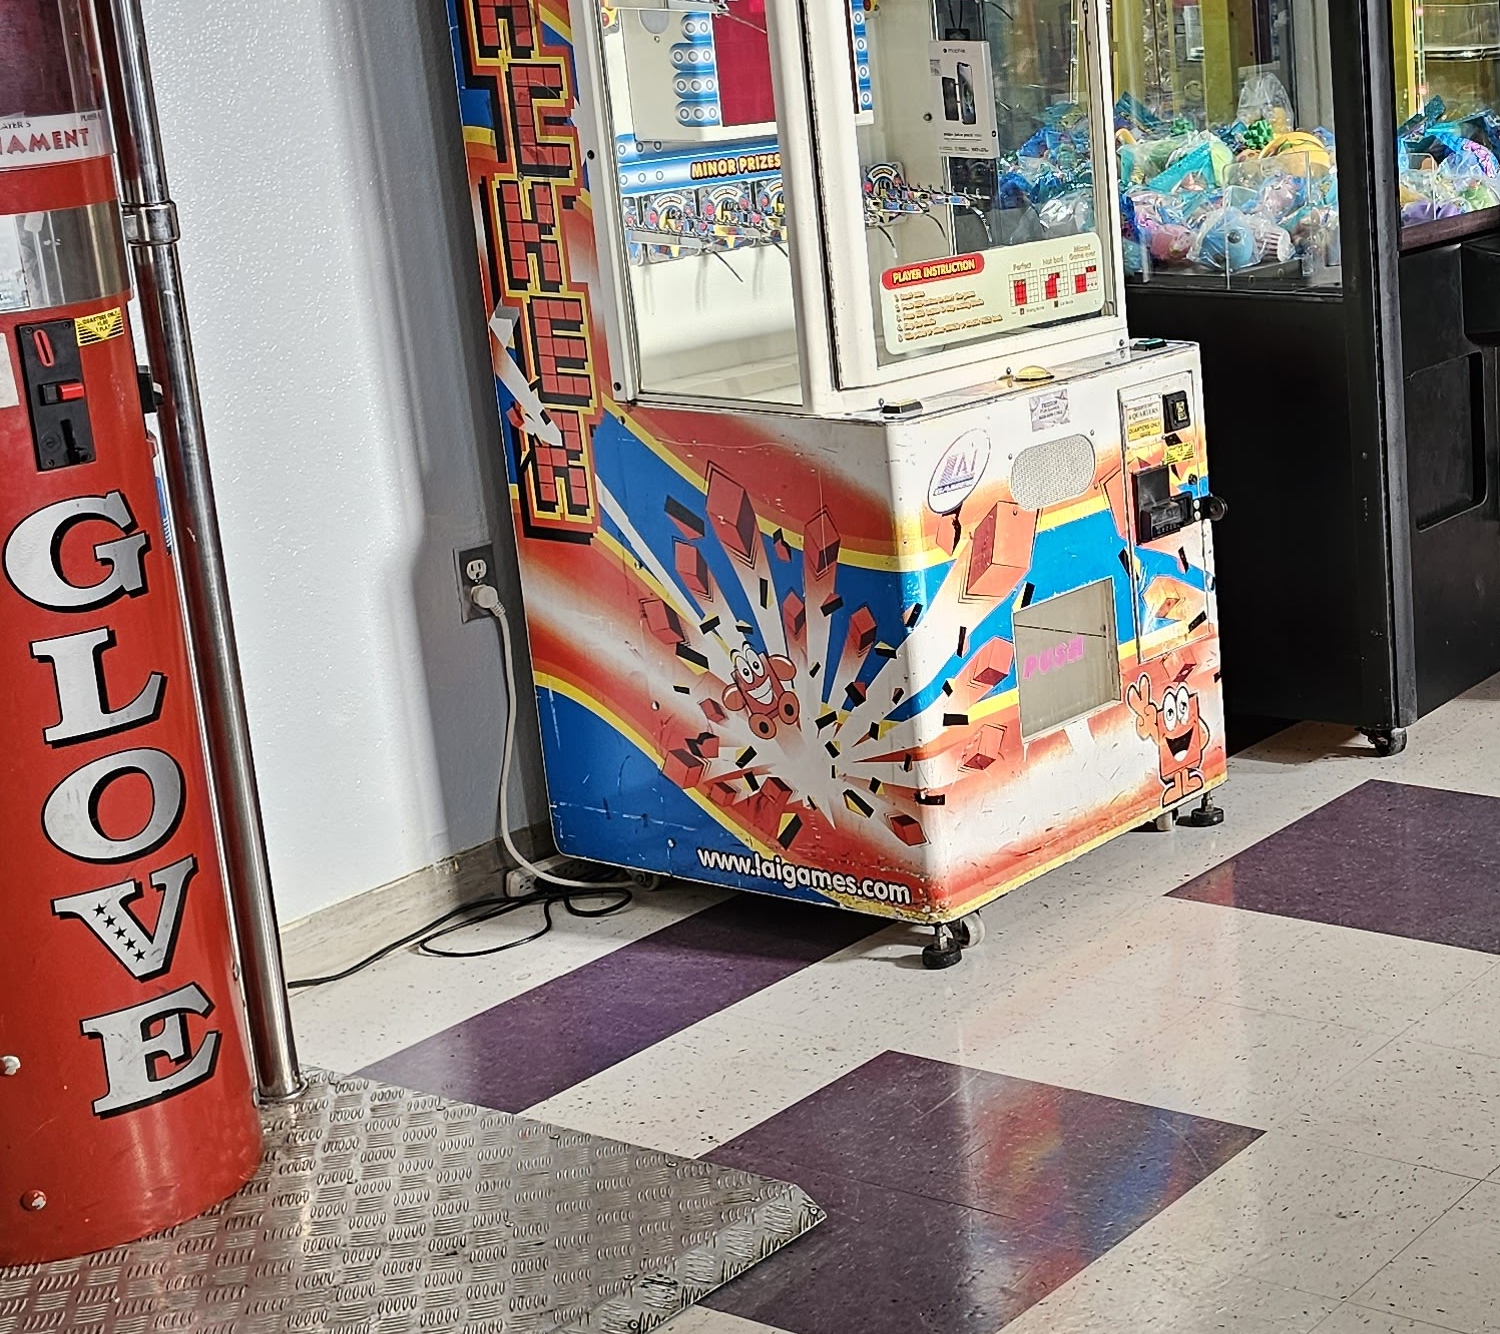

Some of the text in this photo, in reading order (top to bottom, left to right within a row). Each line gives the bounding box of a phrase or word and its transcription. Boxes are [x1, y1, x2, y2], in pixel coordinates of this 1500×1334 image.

[691, 152, 781, 180] MINOR PRIZES
[892, 258, 977, 285] PLAYER INSTRUCTION
[1023, 635, 1085, 681] PUSH
[3, 491, 221, 1120] GLOVE
[697, 848, 911, 904] www.laigames.com
